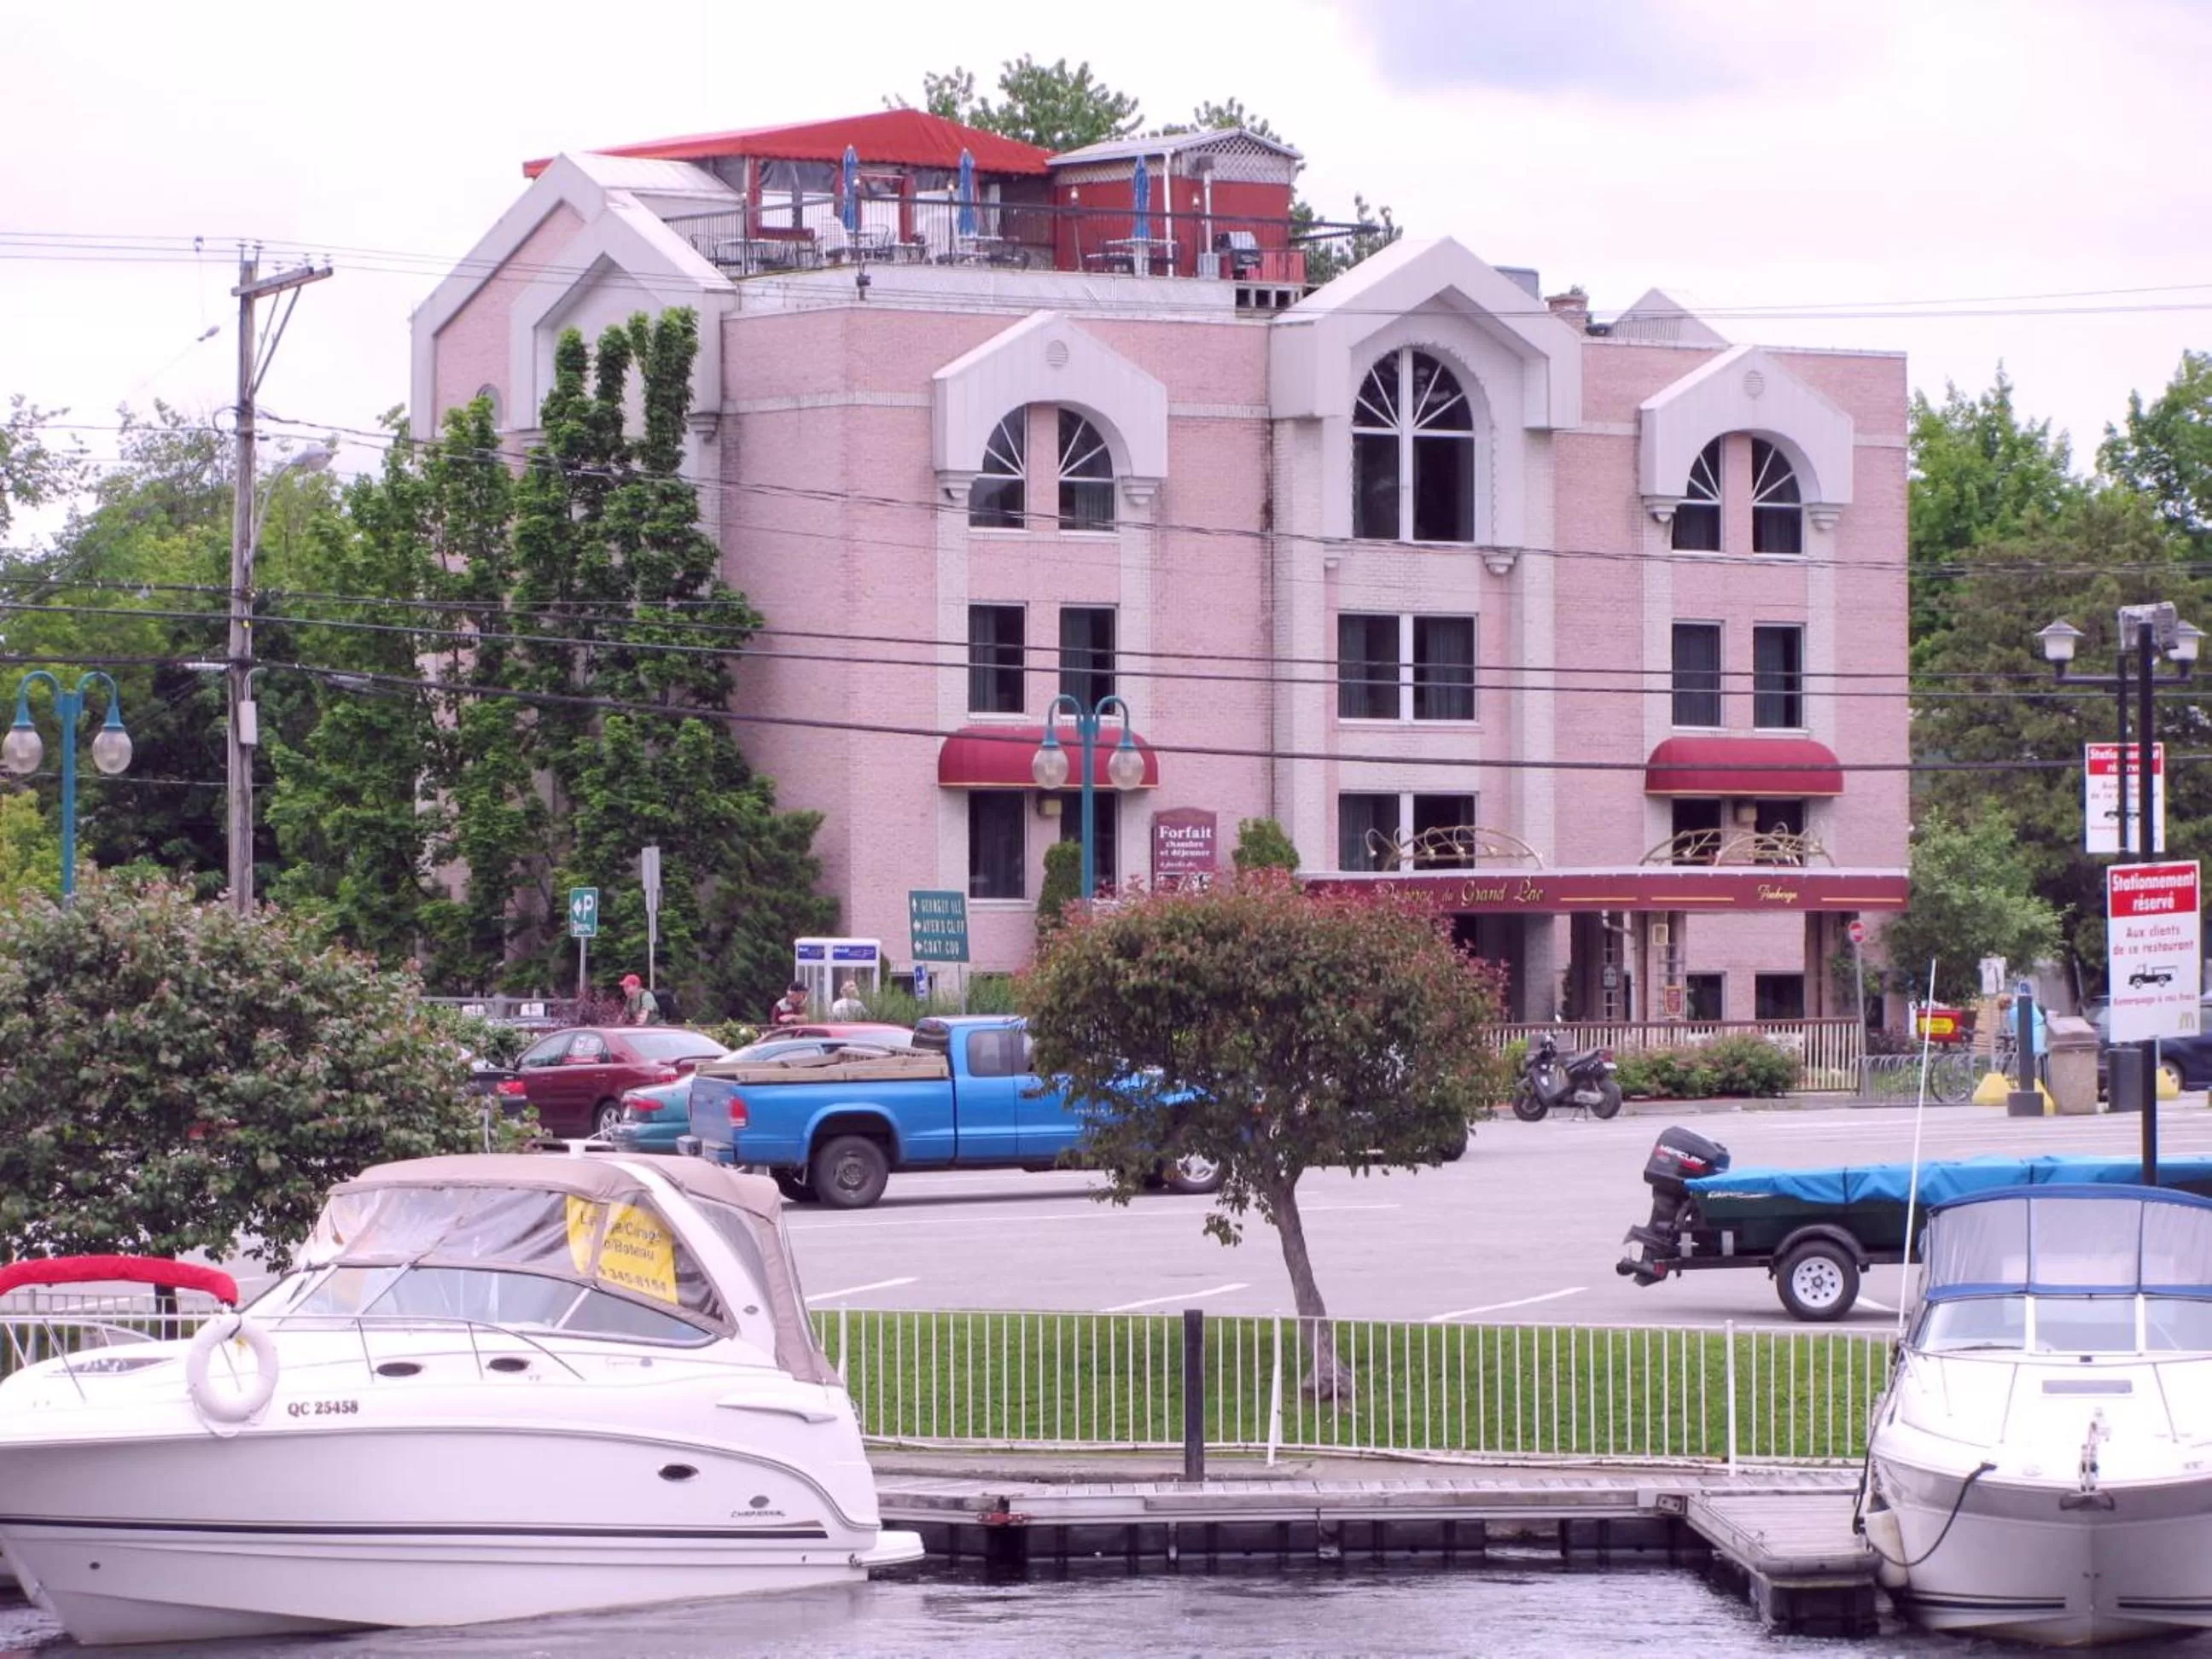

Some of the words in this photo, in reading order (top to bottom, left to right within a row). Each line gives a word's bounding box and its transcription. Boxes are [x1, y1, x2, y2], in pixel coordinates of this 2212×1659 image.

[1159, 825, 1212, 838] Forfait
[2112, 871, 2195, 892] Stationnement
[1460, 880, 1508, 907] Grand
[1513, 876, 1544, 903] Lac
[584, 894, 594, 921] P
[2133, 891, 2175, 912] réservé
[2126, 927, 2145, 938] Aux
[2149, 925, 2181, 937] clients
[2113, 943, 2124, 955] de
[2128, 945, 2139, 954] ce
[2143, 940, 2194, 953] restaurant
[288, 1402, 310, 1417] QC
[315, 1400, 358, 1415] 25458
